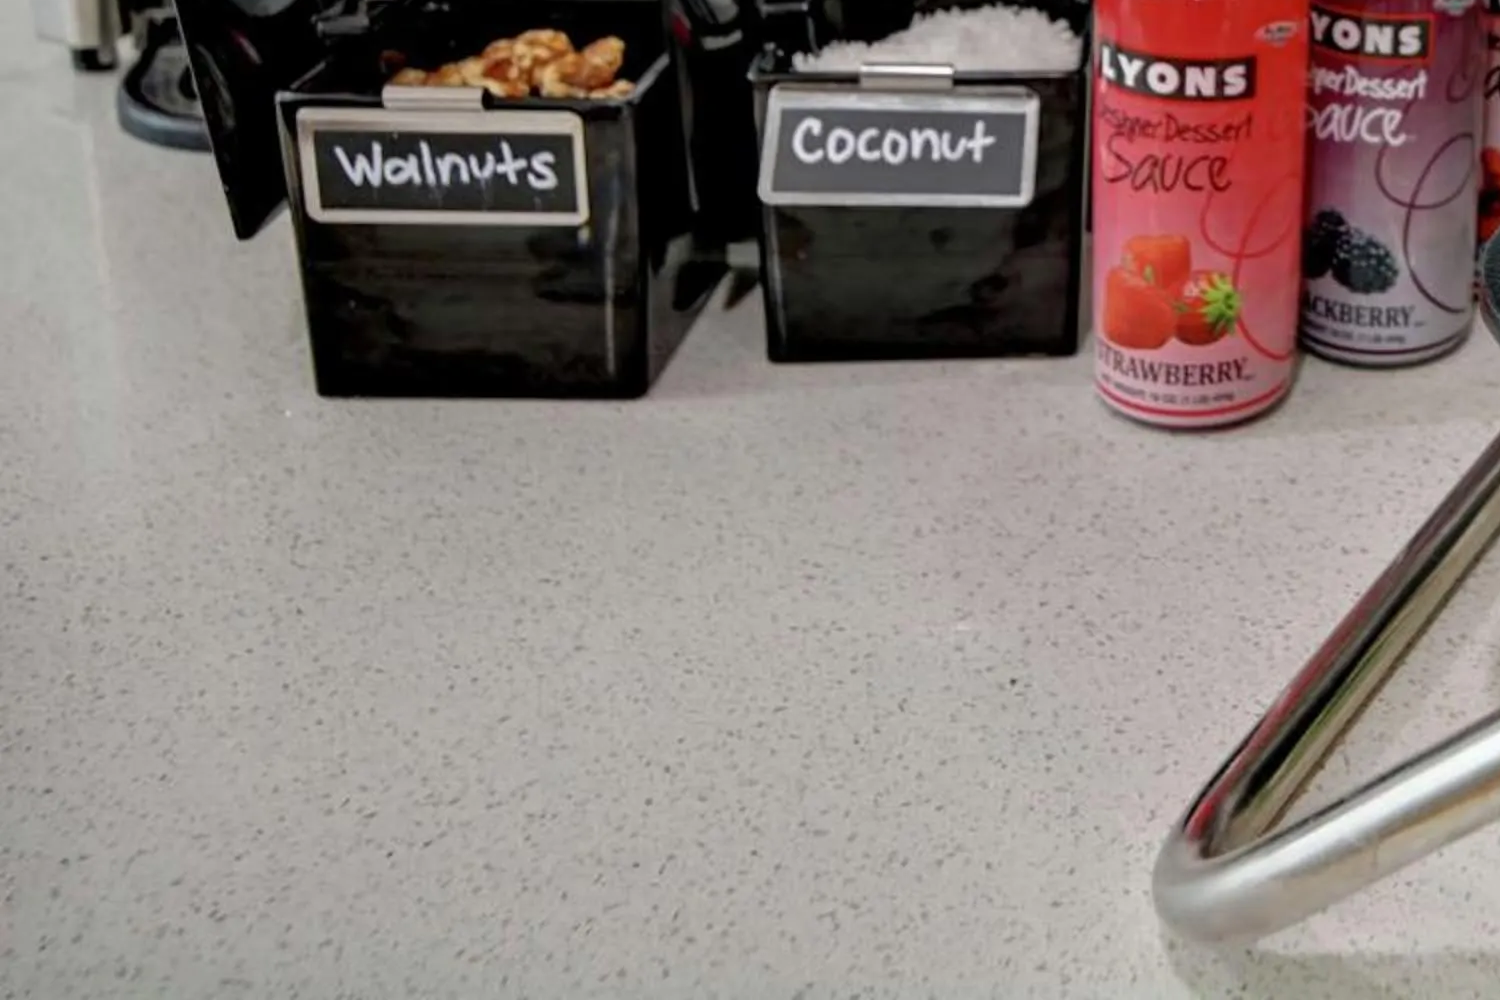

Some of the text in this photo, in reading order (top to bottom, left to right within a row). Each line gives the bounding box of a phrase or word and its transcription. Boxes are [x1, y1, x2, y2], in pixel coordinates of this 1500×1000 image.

[1311, 11, 1422, 56] YONS
[1102, 45, 1249, 97] LYONS
[1344, 65, 1428, 99] Dessert
[792, 115, 997, 165] Coconut
[1164, 113, 1252, 144] Dessert
[334, 139, 559, 190] Walnuts
[1104, 132, 1232, 194] Sauce
